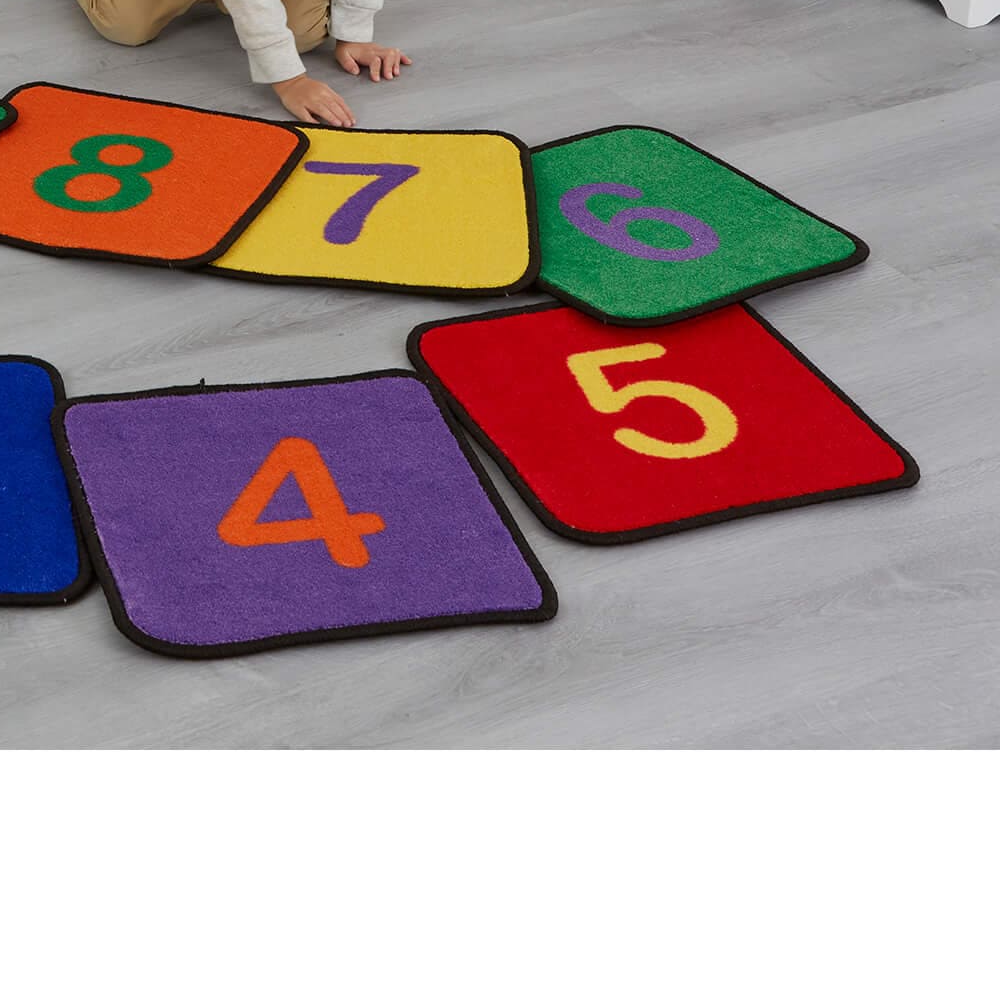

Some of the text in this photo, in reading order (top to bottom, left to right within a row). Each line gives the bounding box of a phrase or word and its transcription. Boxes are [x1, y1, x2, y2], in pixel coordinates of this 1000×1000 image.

[33, 134, 173, 212] 8
[304, 161, 420, 244] 7
[560, 183, 720, 262] 6
[568, 343, 739, 459] 5
[218, 438, 385, 567] 4
